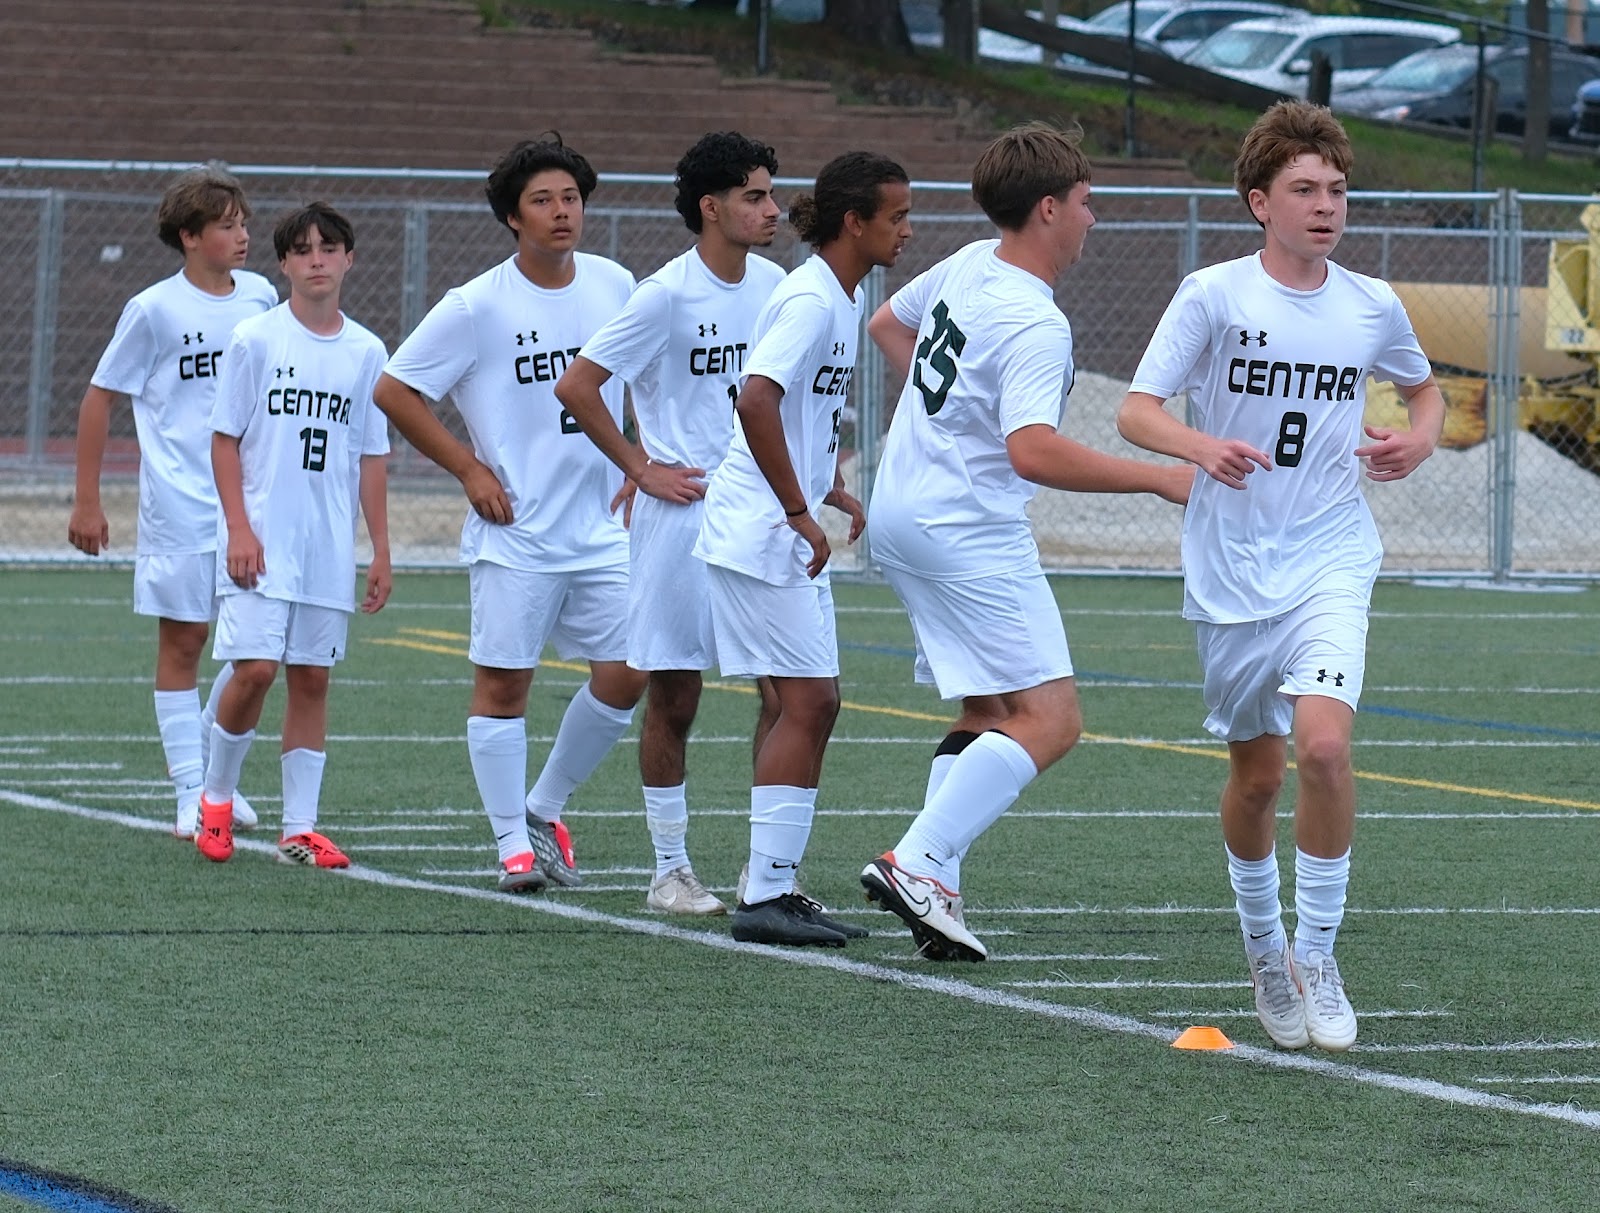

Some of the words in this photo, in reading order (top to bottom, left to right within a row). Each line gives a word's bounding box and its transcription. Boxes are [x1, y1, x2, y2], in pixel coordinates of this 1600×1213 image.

[1228, 357, 1363, 401] CENTRA
[299, 427, 328, 472] 13
[1275, 411, 1308, 468] 8
